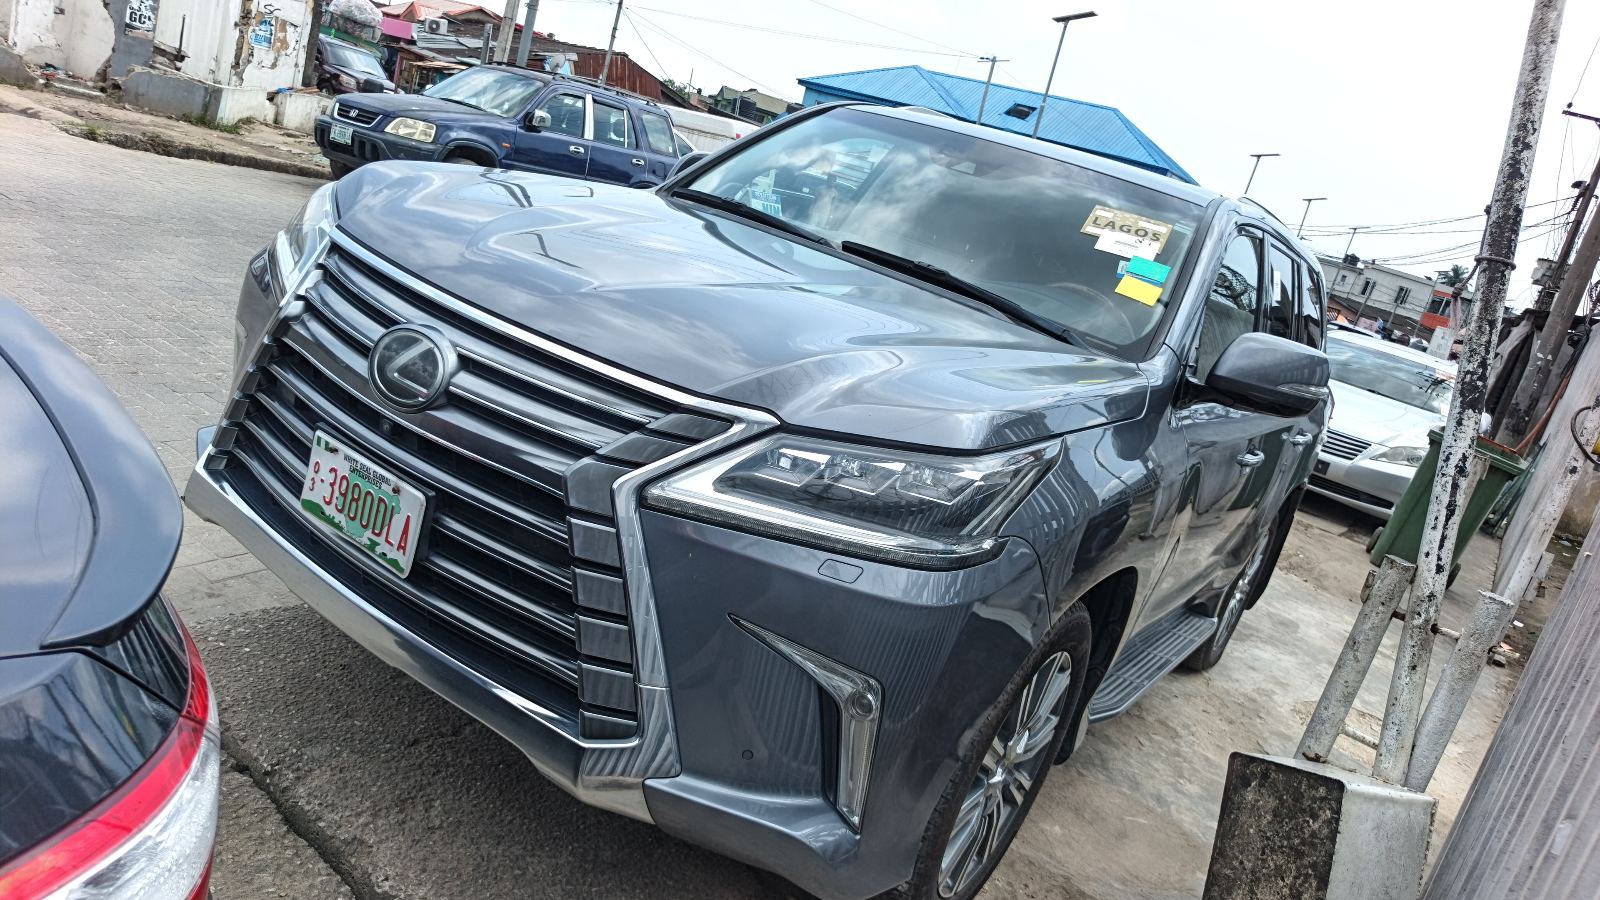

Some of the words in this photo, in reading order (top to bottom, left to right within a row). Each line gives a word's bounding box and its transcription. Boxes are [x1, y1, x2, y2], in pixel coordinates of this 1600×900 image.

[1092, 216, 1161, 242] LAGOS
[344, 453, 359, 468] WHITE
[360, 462, 372, 475] SEAL
[372, 470, 391, 486] GLOBAL
[349, 465, 382, 490] ENTERPRISES
